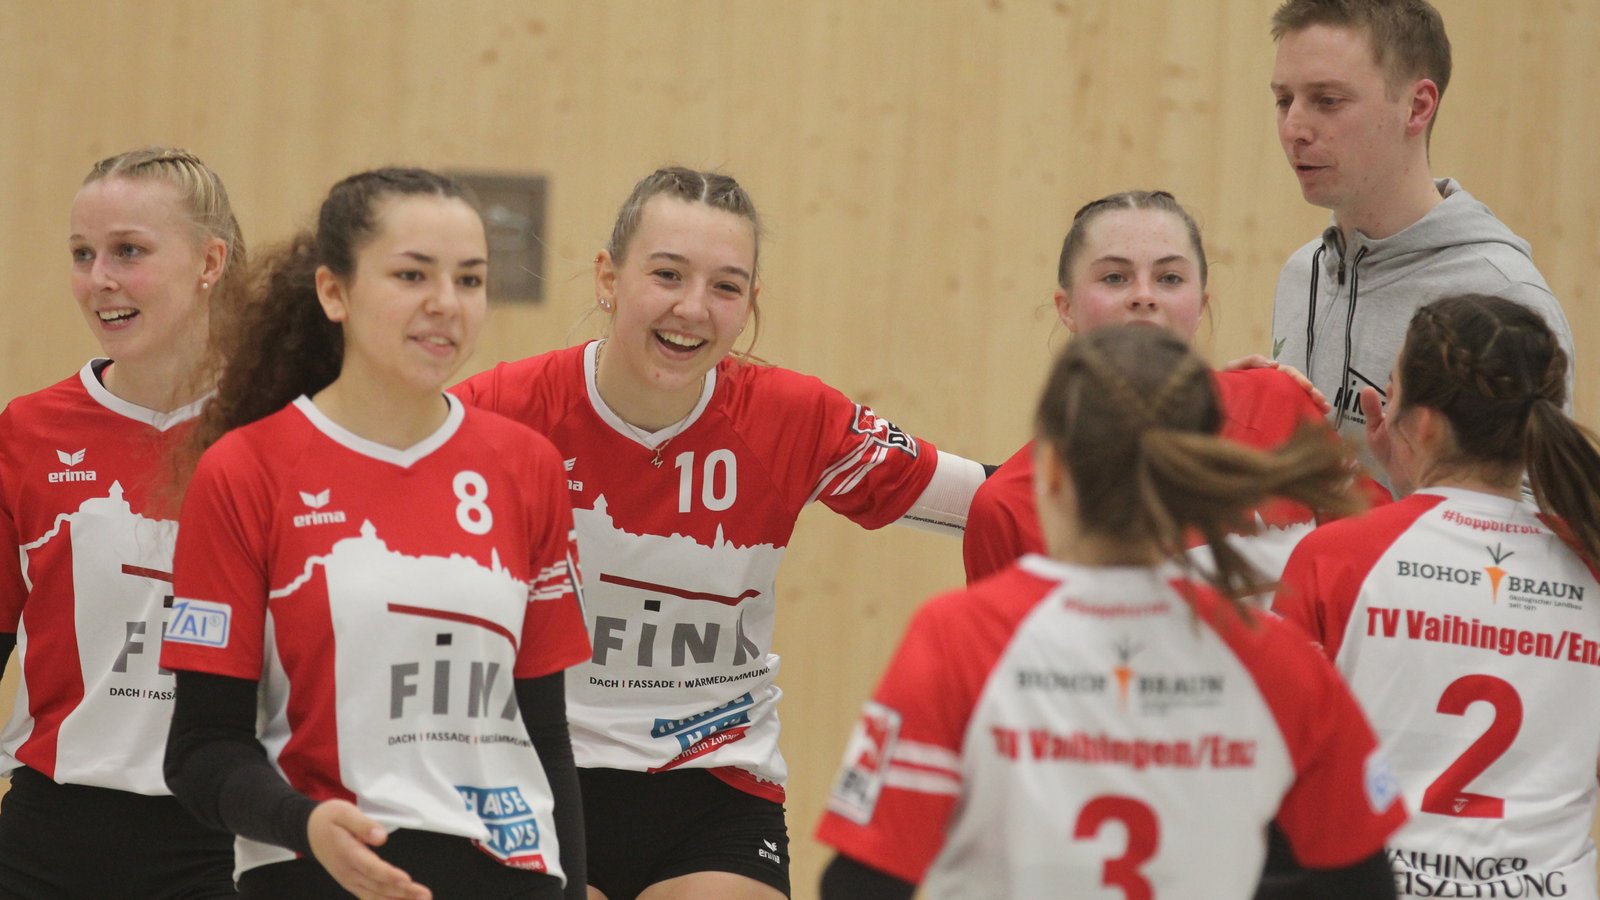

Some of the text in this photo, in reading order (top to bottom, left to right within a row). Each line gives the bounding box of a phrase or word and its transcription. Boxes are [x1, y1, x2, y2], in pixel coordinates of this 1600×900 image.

[48, 469, 97, 483] erima
[675, 448, 738, 513] 10
[453, 470, 494, 535] 8
[293, 509, 346, 528] erima
[1397, 560, 1585, 602] BIOHOF BRAUN
[1367, 606, 1400, 638] TV
[109, 687, 140, 698] DACH
[589, 676, 619, 688] DACH
[628, 679, 675, 689] FASSADE
[388, 732, 417, 746] DACH
[425, 731, 471, 745] FASSADE
[682, 740, 708, 758] mein
[1421, 673, 1524, 819] 2
[1073, 794, 1163, 900] 3
